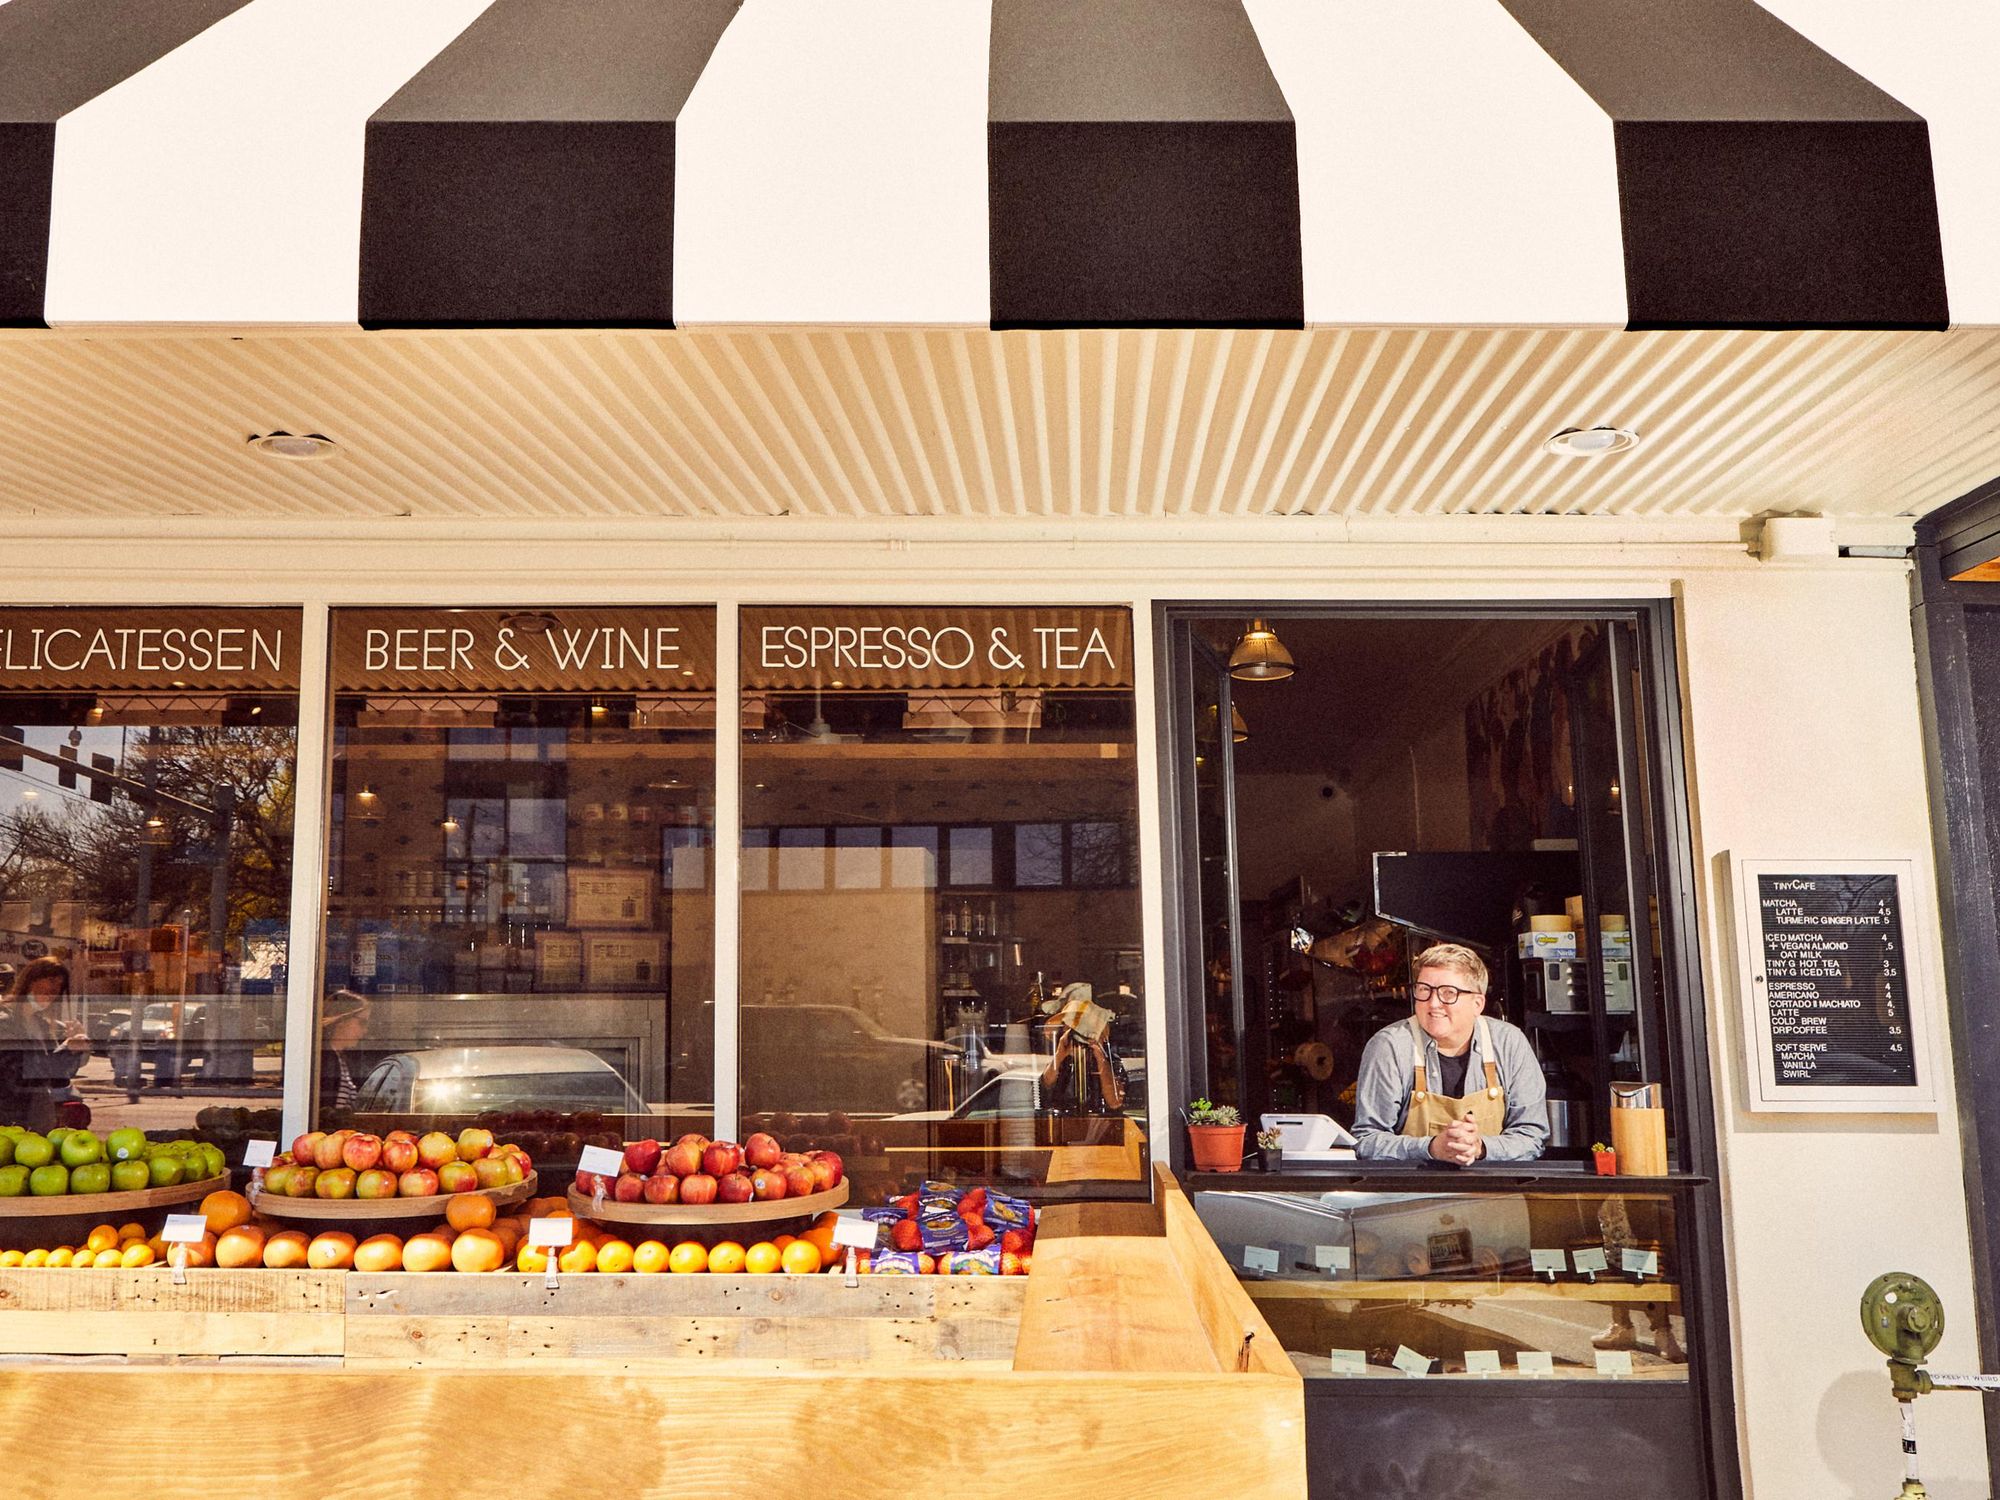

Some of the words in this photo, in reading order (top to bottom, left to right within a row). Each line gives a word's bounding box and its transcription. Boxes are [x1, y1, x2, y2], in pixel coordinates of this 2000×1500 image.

[0, 628, 282, 671] LICATESSEN
[365, 628, 475, 671] BEER
[494, 627, 530, 671] &
[545, 627, 680, 670] WINE
[761, 625, 974, 670] ESPRESSO
[987, 626, 1024, 670] &
[1032, 627, 1115, 670] TEA
[1762, 899, 1798, 908] MATCHA
[1878, 899, 1884, 907] 4
[1775, 908, 1804, 916] LATTE
[1878, 908, 1892, 916] 4.5
[1776, 916, 1819, 925] TURMERIC
[1820, 916, 1853, 925] GINGER
[1854, 916, 1881, 925] LATTE
[1884, 916, 1890, 925] 5
[1765, 934, 1787, 942] ICED
[1787, 934, 1824, 942] MATCHA
[1881, 934, 1888, 942] 4
[1780, 942, 1811, 951] VEGAN
[1811, 942, 1849, 951] ALMOND
[1780, 951, 1797, 959] OAT
[1799, 951, 1822, 959] MILK
[1766, 960, 1786, 968] TINY
[1788, 960, 1796, 968] G
[1799, 960, 1818, 968] HOT
[1821, 960, 1840, 968] TEA
[1883, 960, 1890, 968] 3
[1766, 968, 1787, 976] TINY
[1789, 968, 1797, 976] G
[1800, 968, 1823, 976] ICED
[1823, 968, 1842, 976] TEA
[1768, 982, 1816, 991] ESPRESSO
[1885, 982, 1891, 991] 4
[1768, 991, 1820, 999] AMERICANO
[1885, 991, 1892, 999] 4
[1769, 1000, 1811, 1008] CORTADO
[1771, 1008, 1800, 1017] LATTE
[1888, 1009, 1894, 1017] 5
[1771, 1017, 1796, 1026] COLD
[1801, 1017, 1827, 1026] BREW
[1775, 1043, 1798, 1052] SOFT
[1799, 1043, 1828, 1053] SERVE
[1782, 1060, 1817, 1069] VANILLA
[1783, 1069, 1811, 1078] SWIRL
